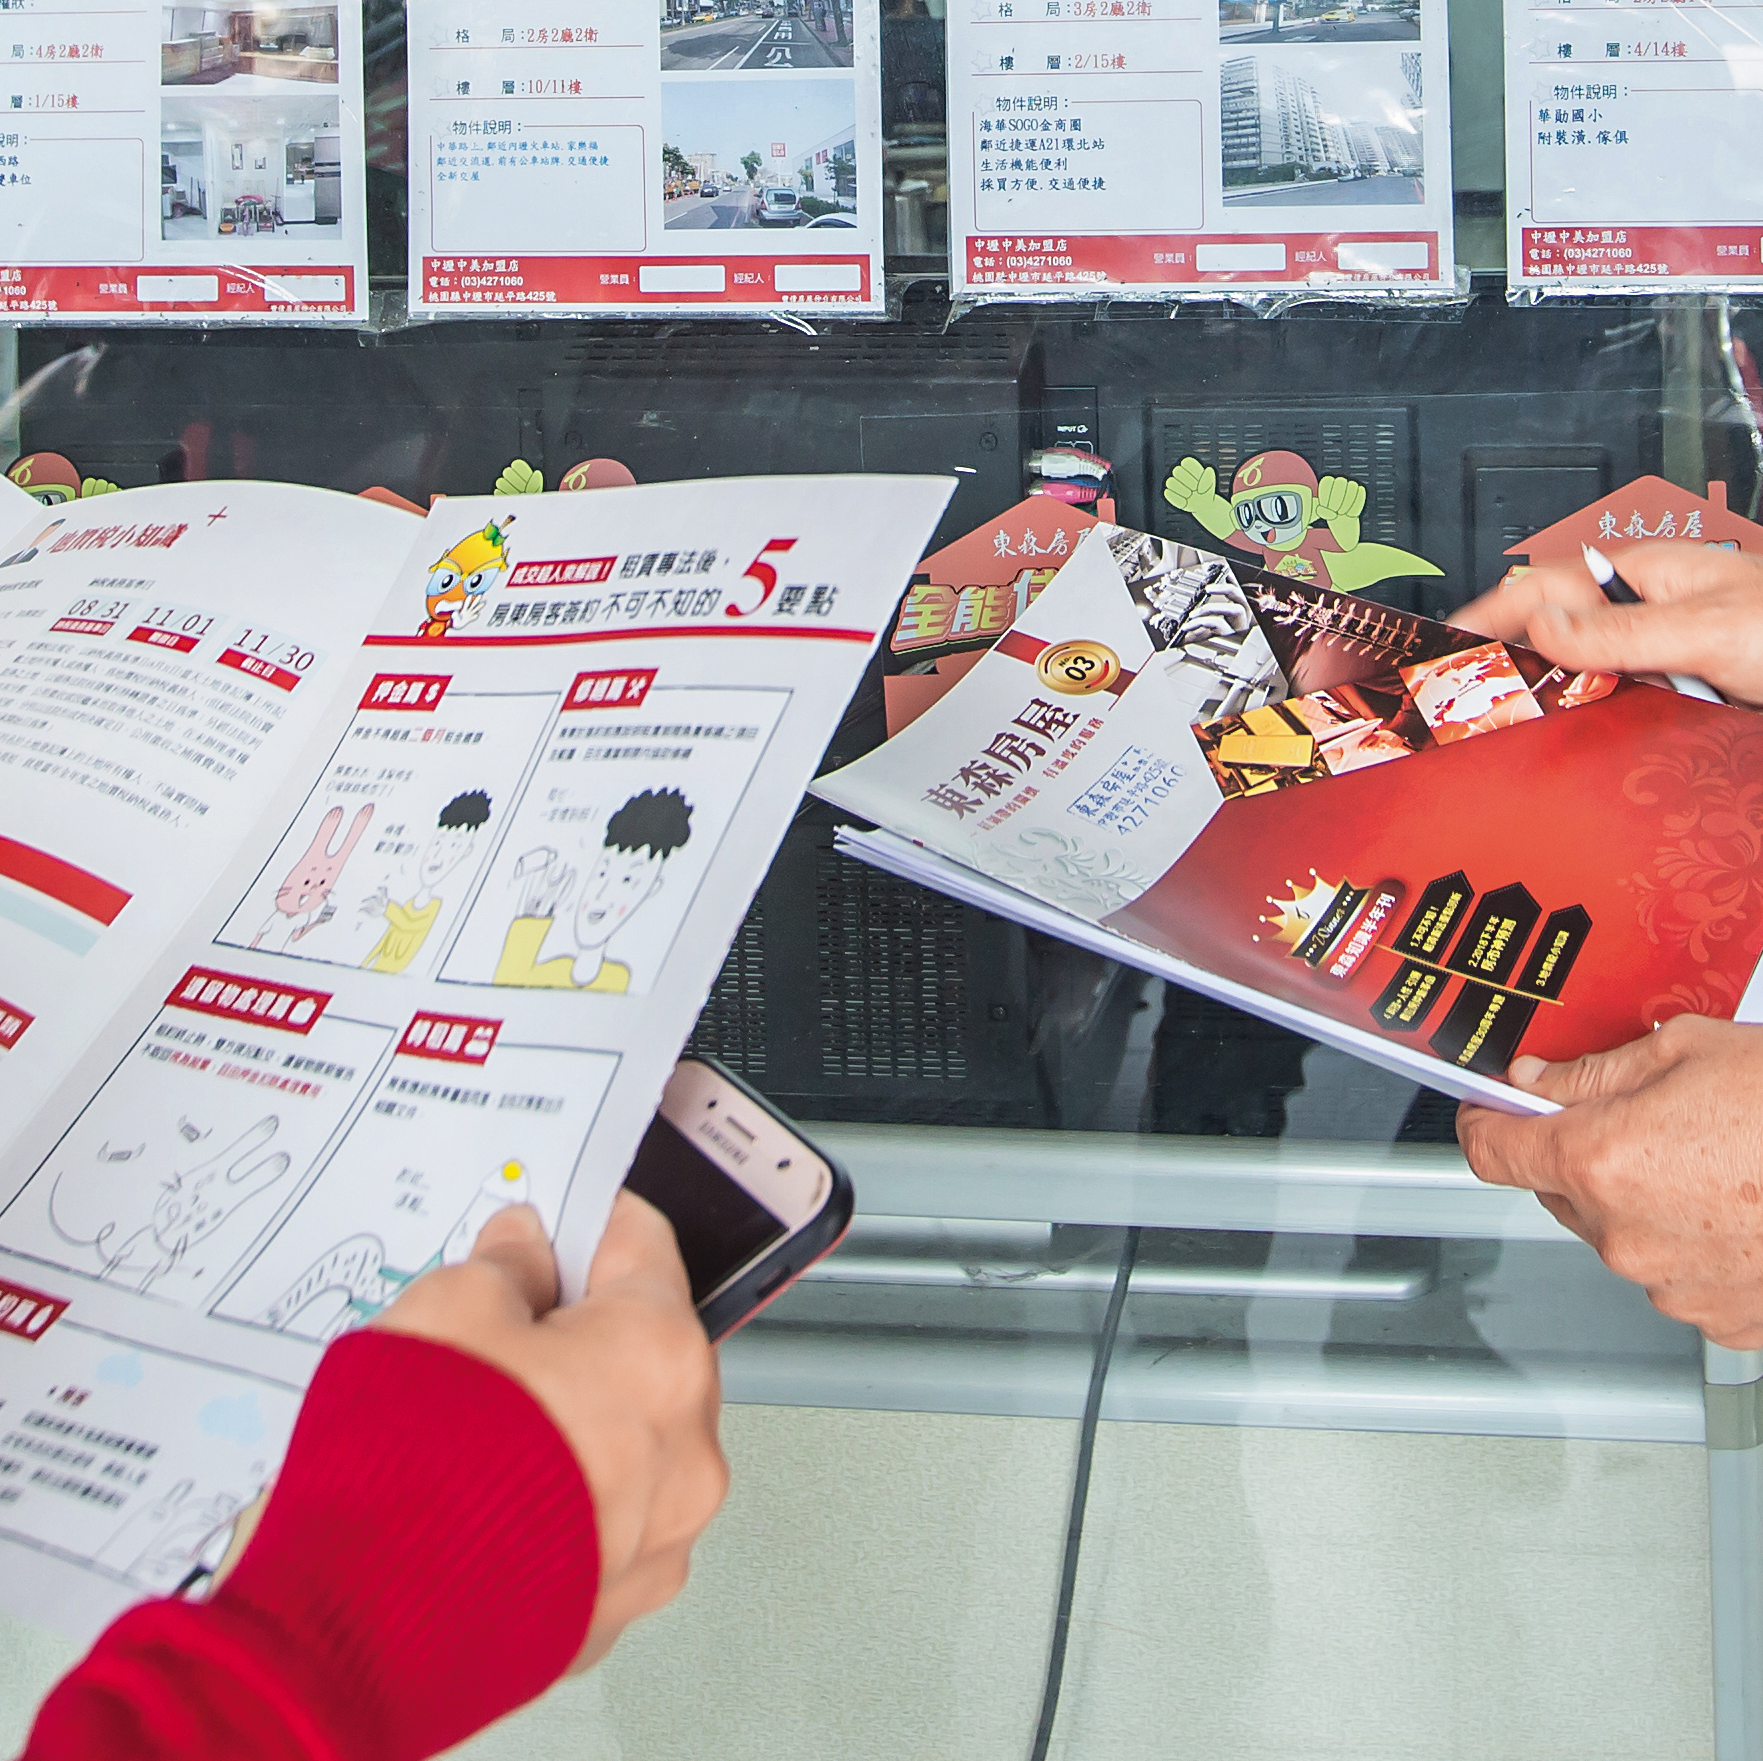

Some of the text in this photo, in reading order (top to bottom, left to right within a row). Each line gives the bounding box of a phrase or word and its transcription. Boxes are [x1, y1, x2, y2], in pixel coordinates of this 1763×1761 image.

[998, 0, 1153, 19] 格局：3房2廳2衛
[455, 27, 599, 44] 格局：2房2廳2衛
[1557, 41, 1688, 59] 樓層：4/14樓
[999, 54, 1127, 72] 樓層：2/15樓
[1554, 84, 1629, 101] 物件說明：
[995, 95, 1070, 112] 物件說明：
[1537, 107, 1603, 124] 華勛國小
[452, 119, 522, 136] 物件說明：
[979, 118, 1082, 133] 海華SOGO金商圈
[979, 137, 1105, 153] 鄰近捷運A21環北站
[981, 157, 1068, 173] 生活機能便利
[972, 254, 1072, 269] 電話：(03)4271060
[1529, 246, 1632, 261] 電話：(03)4271060
[428, 275, 524, 288] 電話：(03)4271060
[1597, 509, 1704, 540] 東森房屋
[724, 538, 799, 618] 5
[772, 584, 837, 617] 要點
[67, 596, 130, 623] 08/31
[141, 605, 216, 638] 11/01
[232, 626, 316, 673] 11/30
[1064, 655, 1096, 684] 03
[921, 697, 1081, 822] 東森房屋
[1310, 902, 1347, 948] Winner
